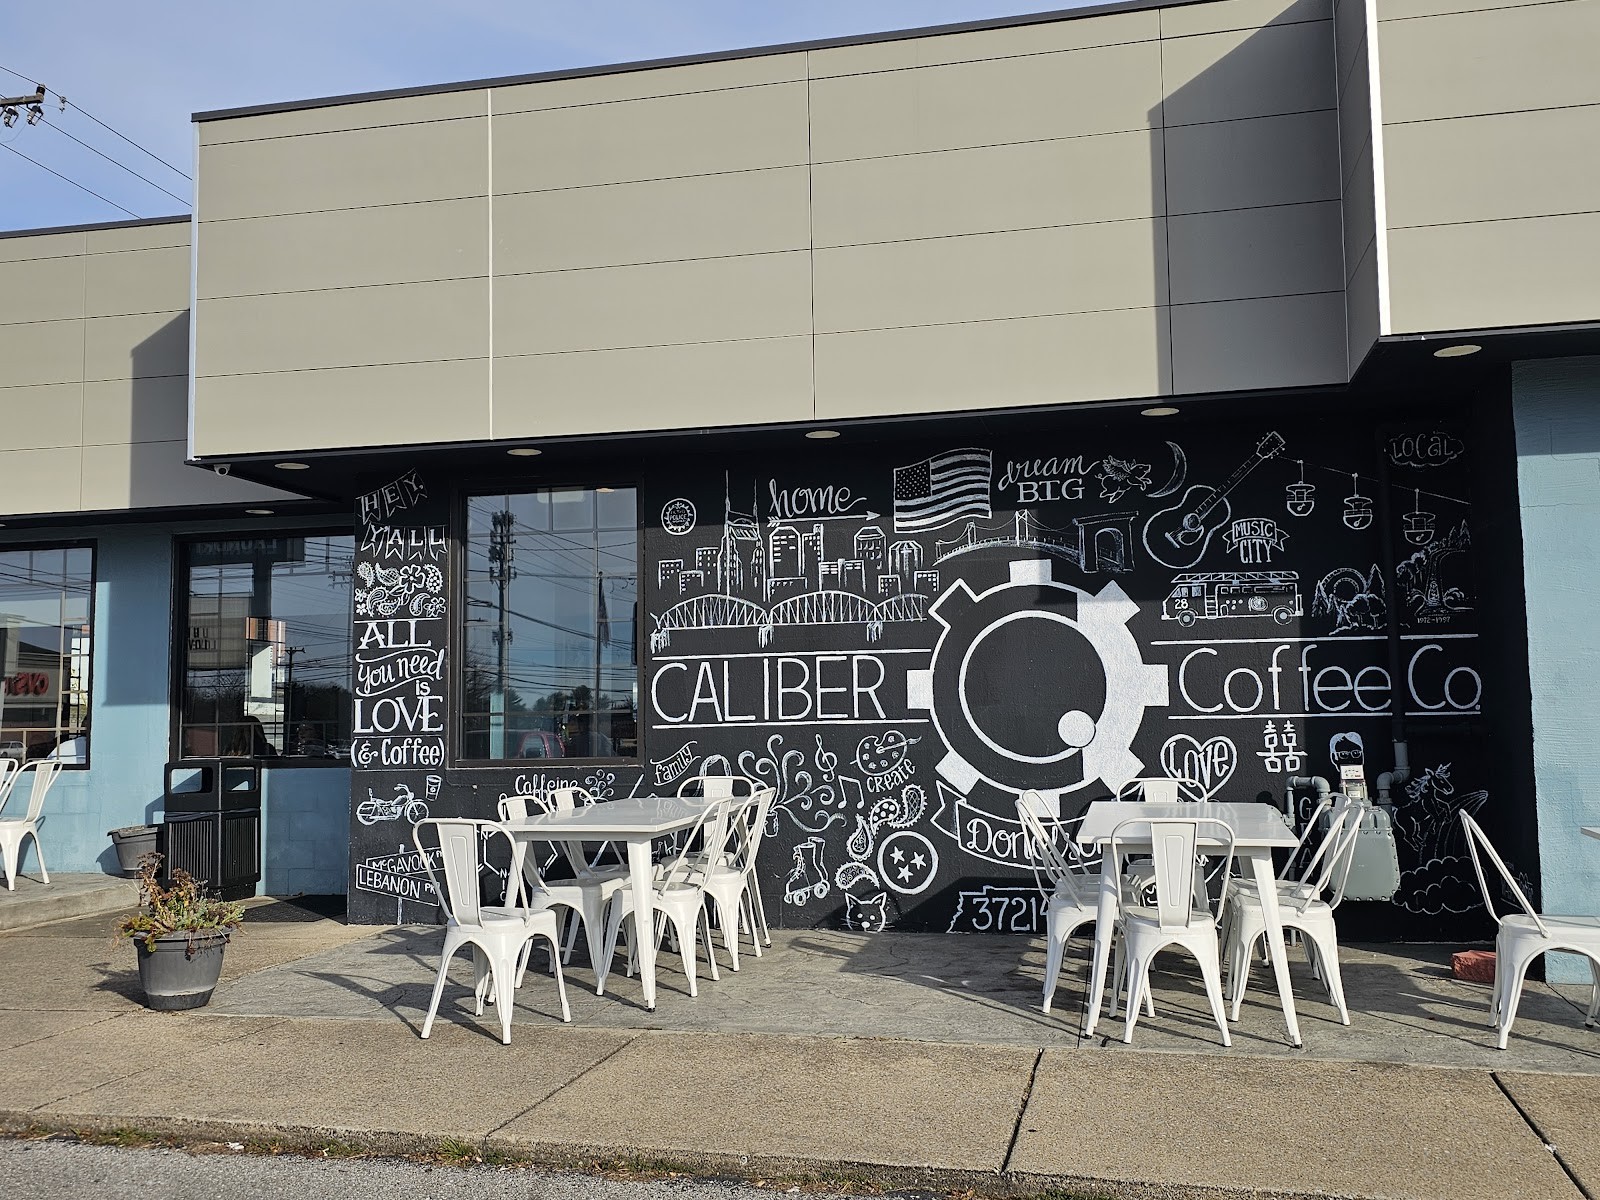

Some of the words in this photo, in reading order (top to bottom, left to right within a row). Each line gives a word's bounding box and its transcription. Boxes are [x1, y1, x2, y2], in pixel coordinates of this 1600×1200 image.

[998, 455, 1100, 491] dream
[768, 478, 867, 518] home
[1017, 478, 1085, 502] BIG
[1235, 521, 1273, 537] MUSIC
[1240, 539, 1272, 564] CITY
[1174, 599, 1188, 609] 28
[357, 621, 432, 649] ALL
[357, 664, 395, 694] you
[396, 648, 444, 680] need
[651, 655, 886, 722] CALIBER
[1178, 644, 1391, 712] Coffee
[1407, 643, 1481, 710] Co.
[415, 680, 430, 696] is
[352, 696, 444, 733] LOVE
[381, 737, 445, 767] Coffee)
[654, 746, 693, 784] family
[514, 773, 579, 804] Caffeine
[966, 818, 1104, 860] Donelso
[359, 868, 421, 899] LEBANON
